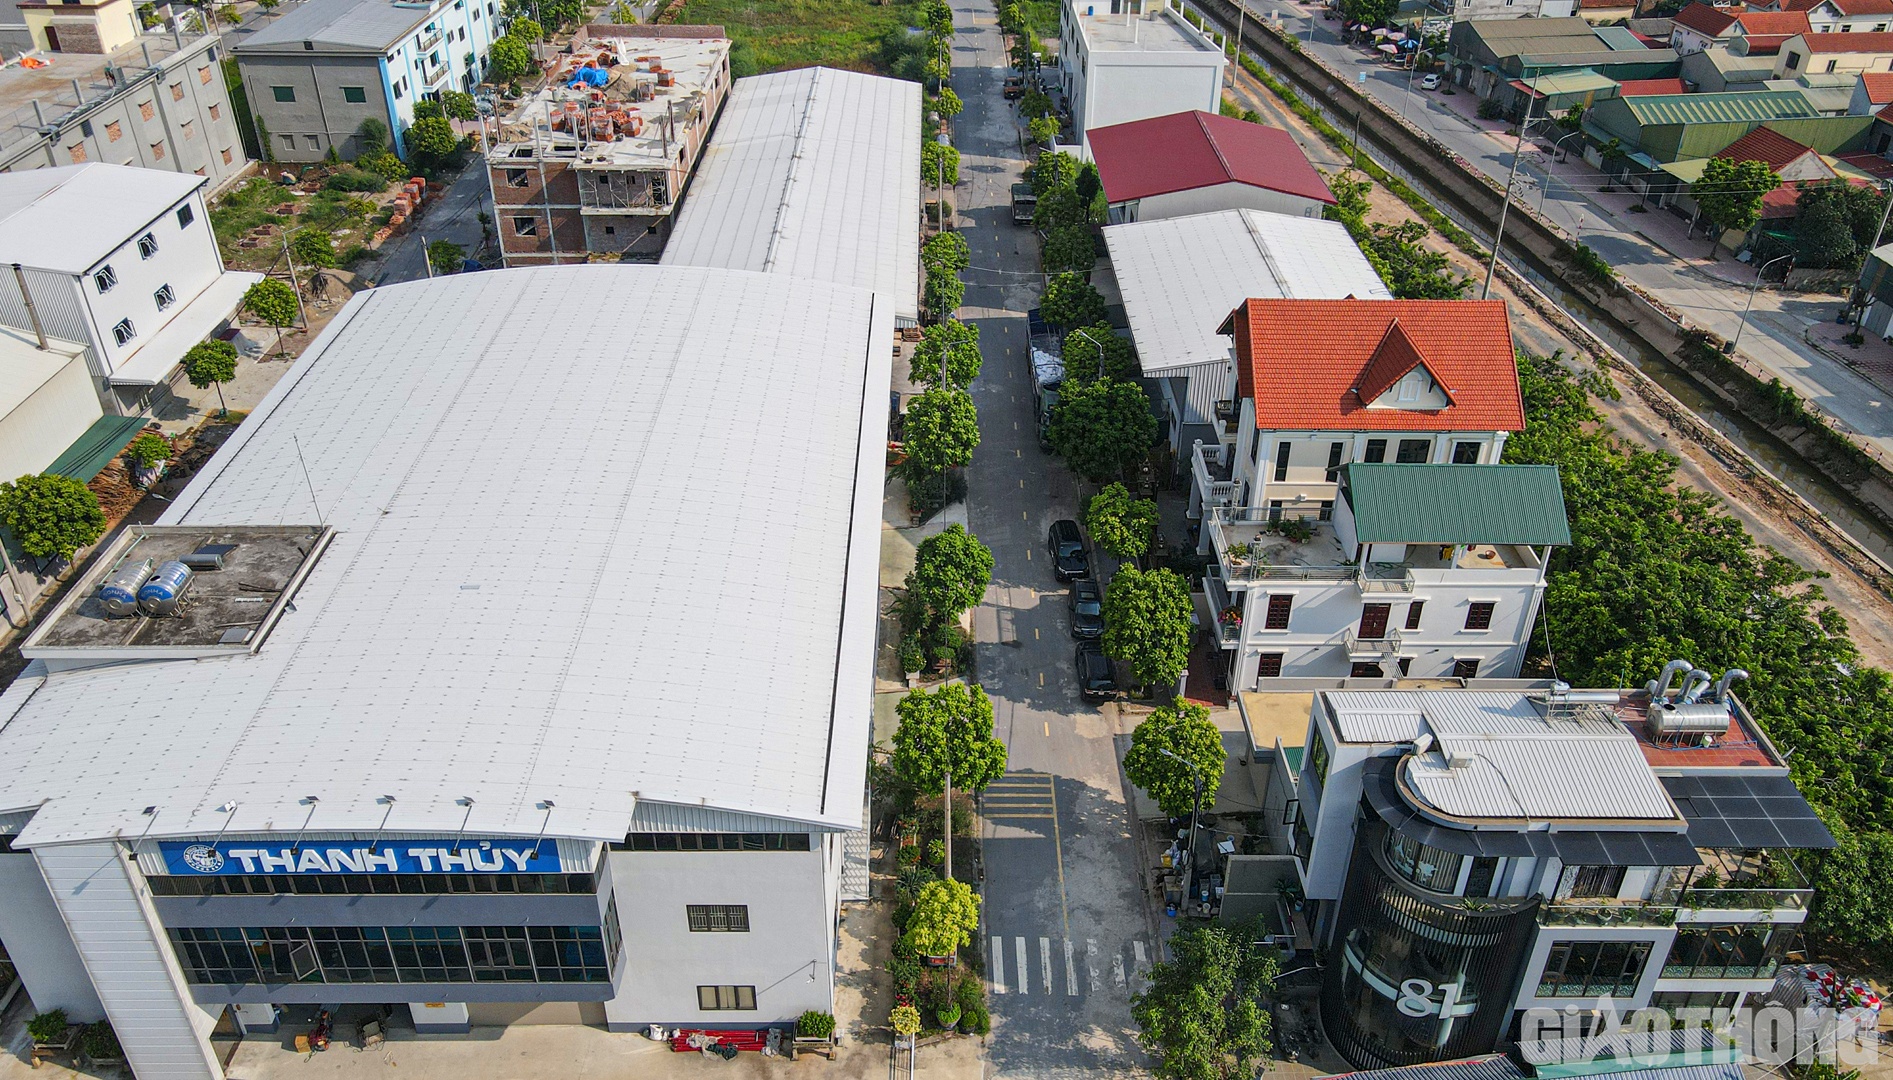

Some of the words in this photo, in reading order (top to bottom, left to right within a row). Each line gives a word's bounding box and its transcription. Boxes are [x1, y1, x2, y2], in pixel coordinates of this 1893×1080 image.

[228, 849, 398, 872] THANH
[408, 841, 534, 872] THỦY
[1396, 978, 1458, 1019] 81
